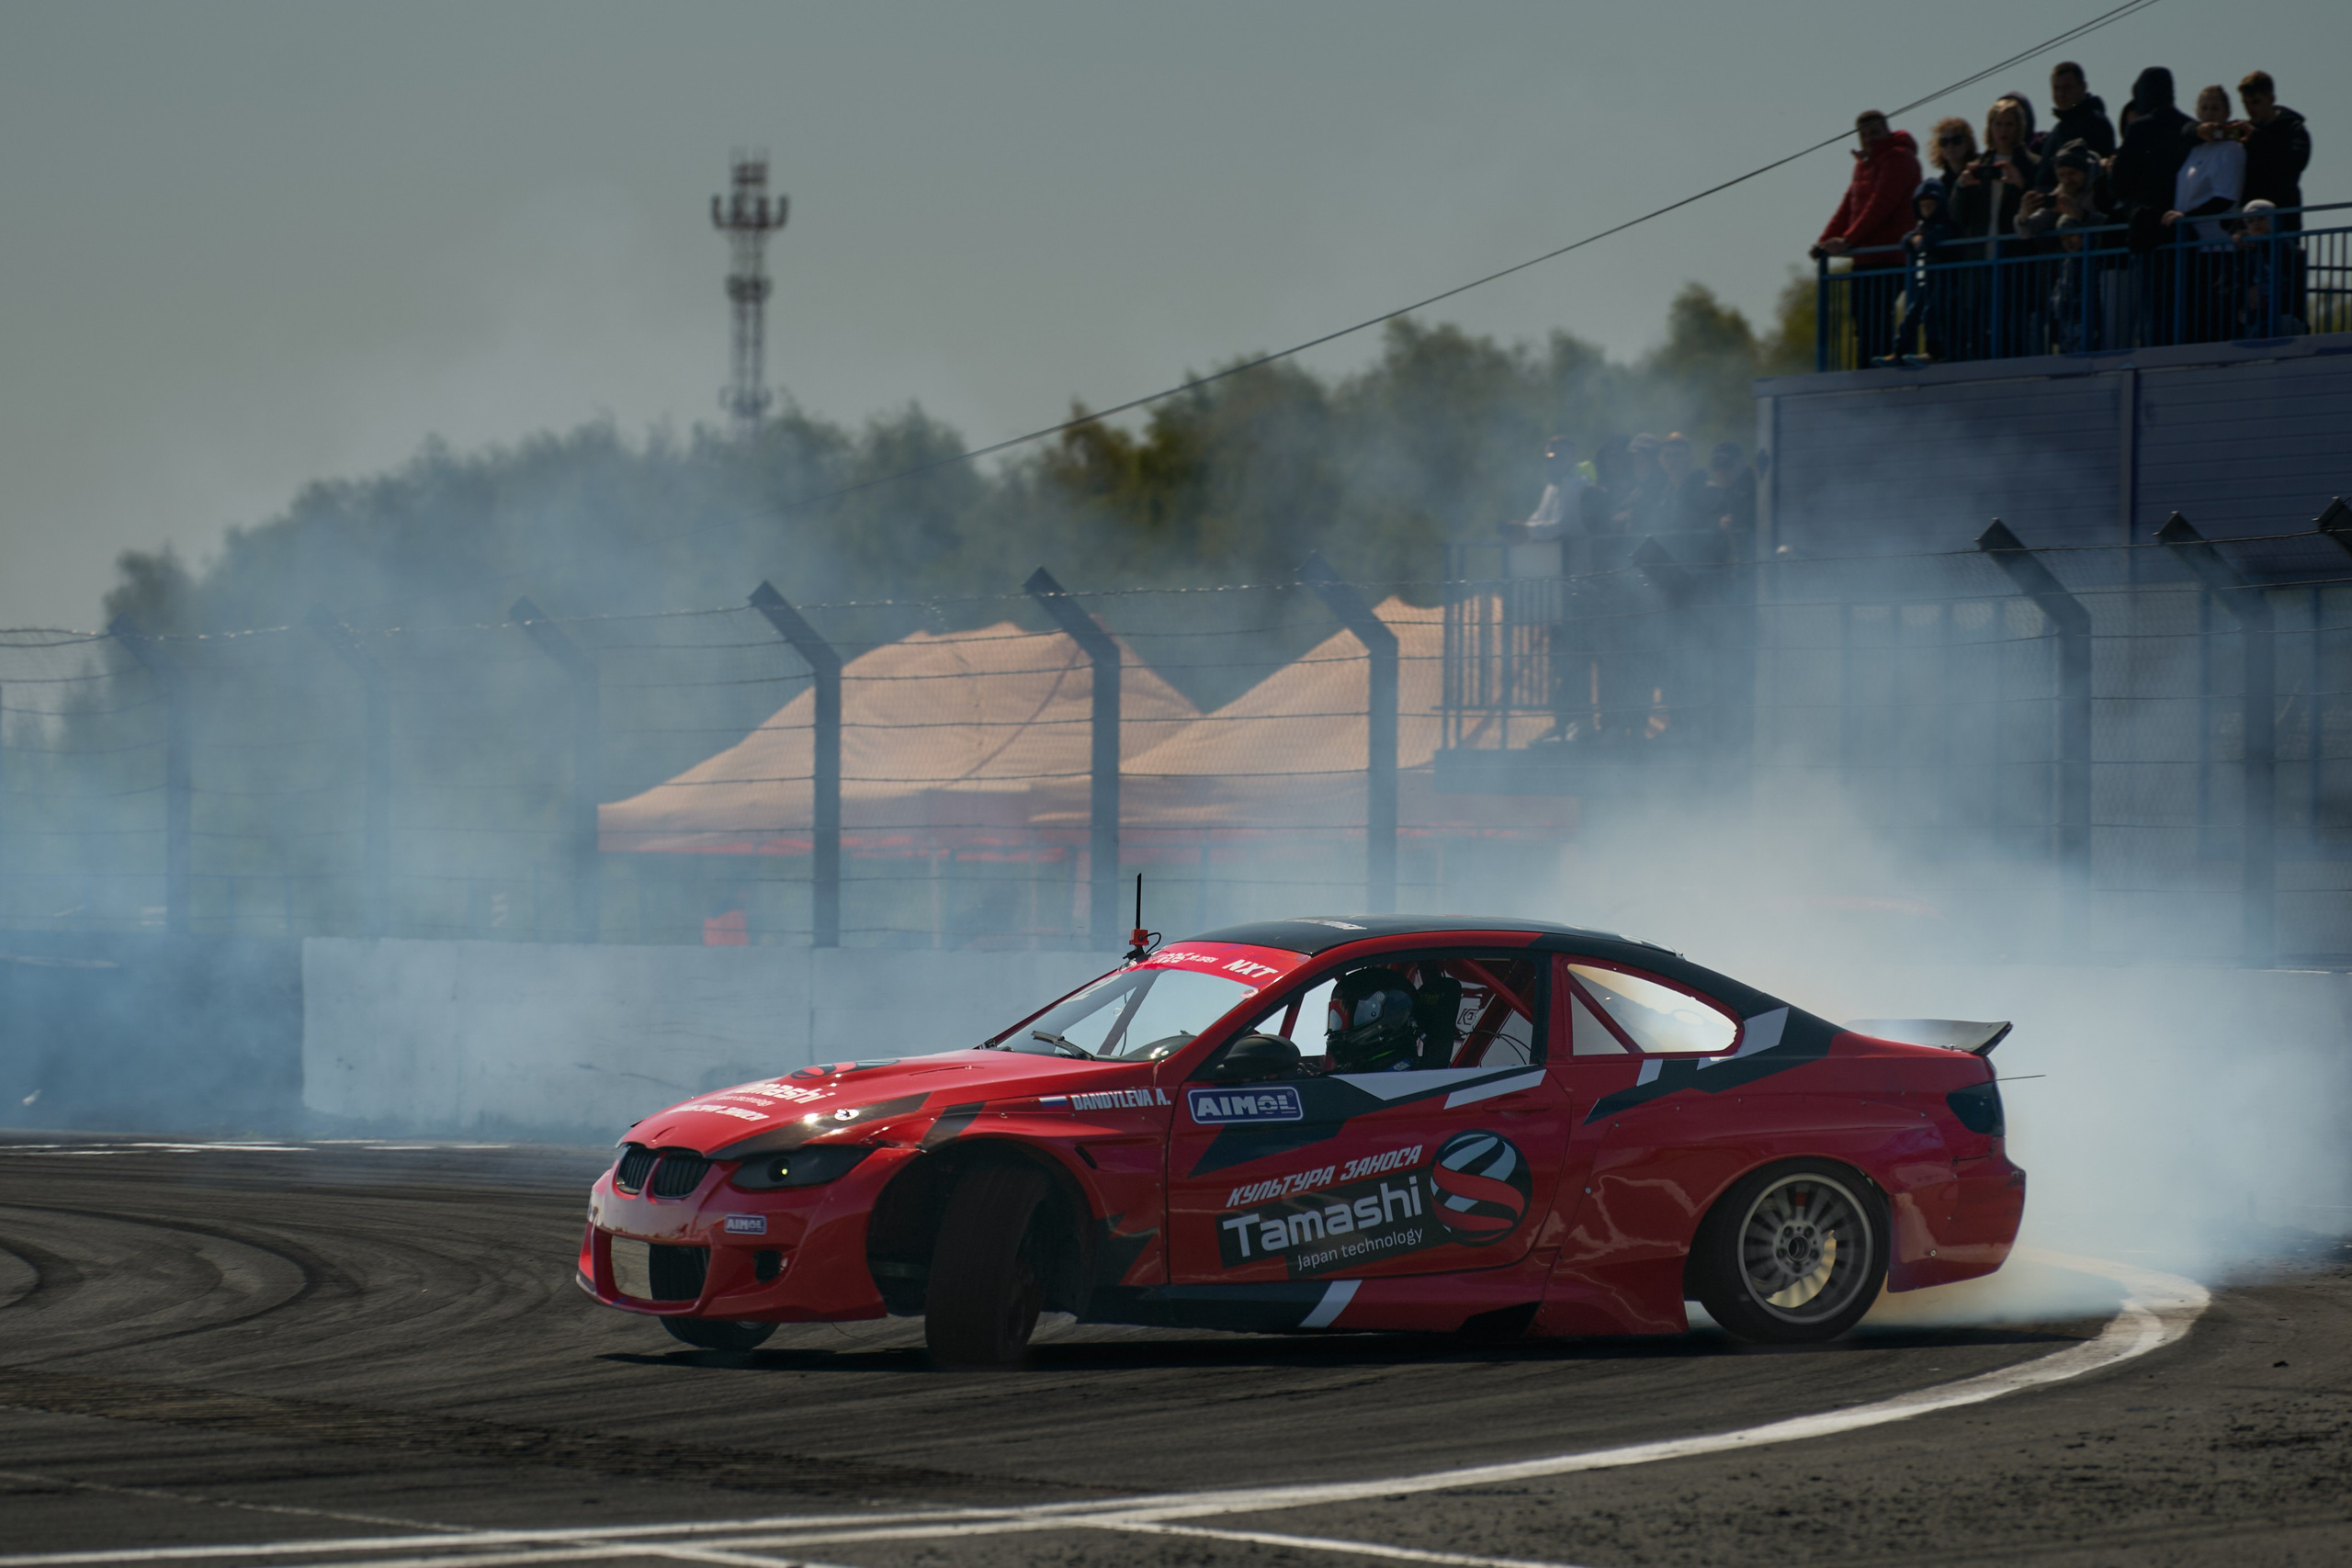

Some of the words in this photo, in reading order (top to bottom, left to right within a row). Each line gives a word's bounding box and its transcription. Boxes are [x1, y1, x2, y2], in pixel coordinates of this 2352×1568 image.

[1222, 959, 1279, 978] NXT
[1069, 1089, 1154, 1111] DANDYLEVA
[1155, 1088, 1171, 1106] A.
[1196, 1094, 1297, 1117] AIMOL
[1226, 1165, 1336, 1209] КУЛЬТУРА
[1340, 1145, 1423, 1181] ЗАНОСА
[1222, 1175, 1423, 1258] Tamashi
[1297, 1248, 1339, 1271] Japan
[1340, 1228, 1423, 1258] technology
